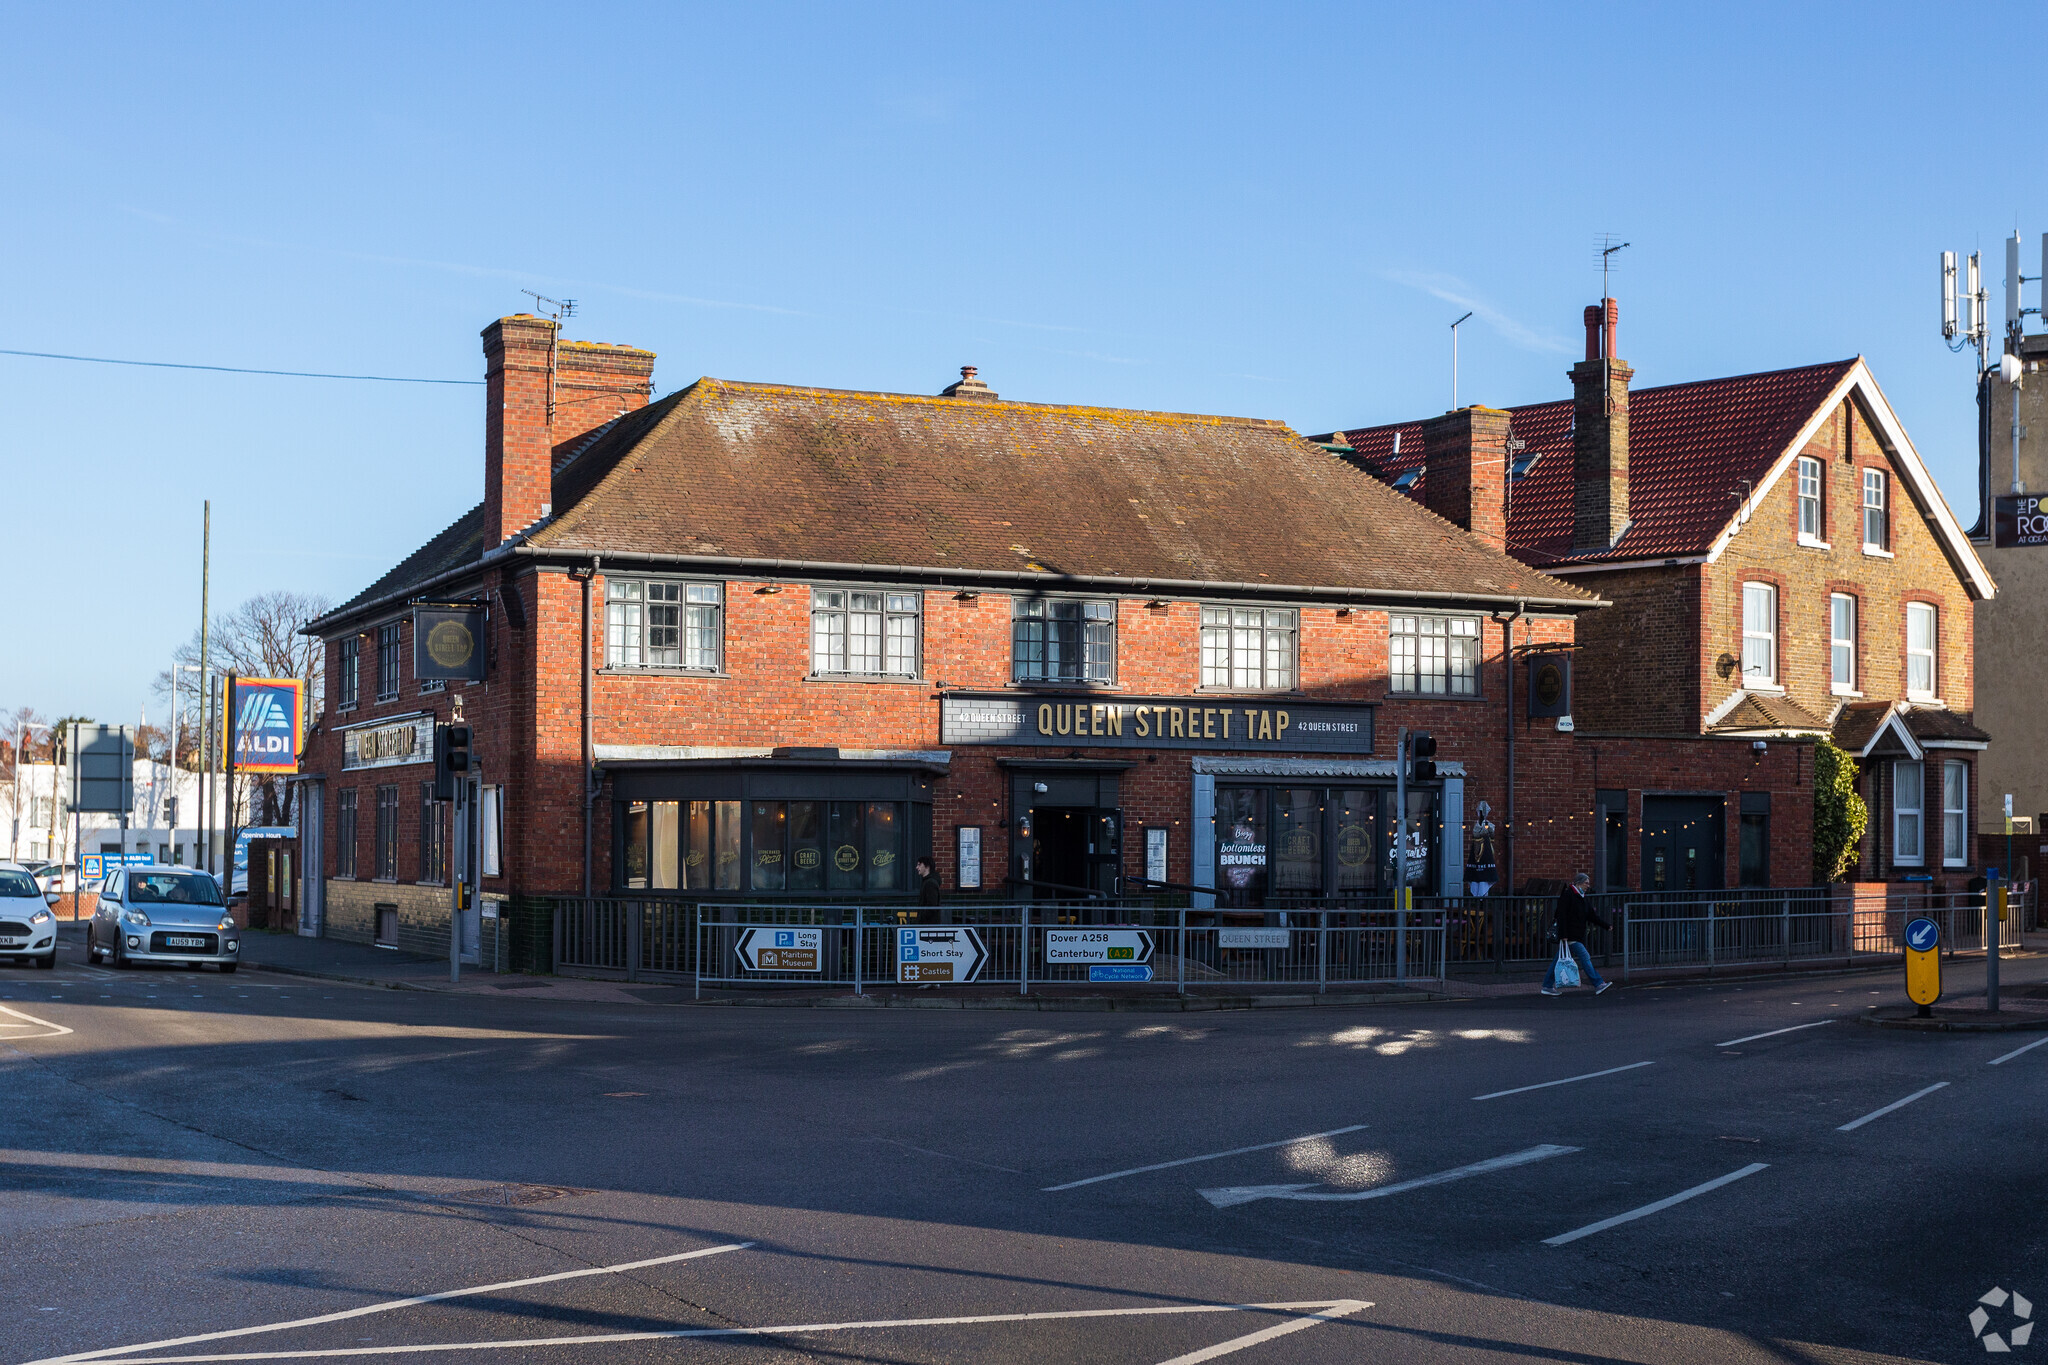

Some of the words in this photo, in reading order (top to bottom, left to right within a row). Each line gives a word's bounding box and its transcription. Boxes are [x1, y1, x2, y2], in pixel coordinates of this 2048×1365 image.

[2017, 499, 2027, 515] THE
[959, 714, 970, 723] 42
[971, 714, 997, 723] QUEEN
[997, 714, 1026, 723] STREET
[1038, 704, 1123, 736] QUEEN
[1135, 706, 1233, 739] STREET
[1244, 709, 1290, 740] TAP
[1298, 722, 1308, 731] 42
[1309, 722, 1331, 732] QUEEN
[1332, 723, 1358, 733] STREET
[236, 735, 290, 753] ALDI
[241, 832, 264, 840] Opening
[1287, 835, 1311, 845] CRAFT
[1220, 843, 1266, 853] bottomless
[1287, 846, 1311, 855] BEERS
[755, 854, 782, 867] Pizza
[872, 851, 896, 867] Cider
[1220, 855, 1266, 866] BRUNCH
[798, 932, 817, 940] Long
[1050, 934, 1078, 942] Dover
[1081, 934, 1109, 942] A258
[1221, 935, 1251, 944] QUEEN
[1254, 935, 1287, 944] STREET
[171, 938, 189, 946] AU59
[800, 940, 818, 948] Stay
[781, 951, 814, 959] Maritime
[945, 950, 964, 959] Stay
[1050, 949, 1105, 959] Canterbury
[1108, 948, 1133, 959] (A2)
[922, 967, 951, 975] Castles
